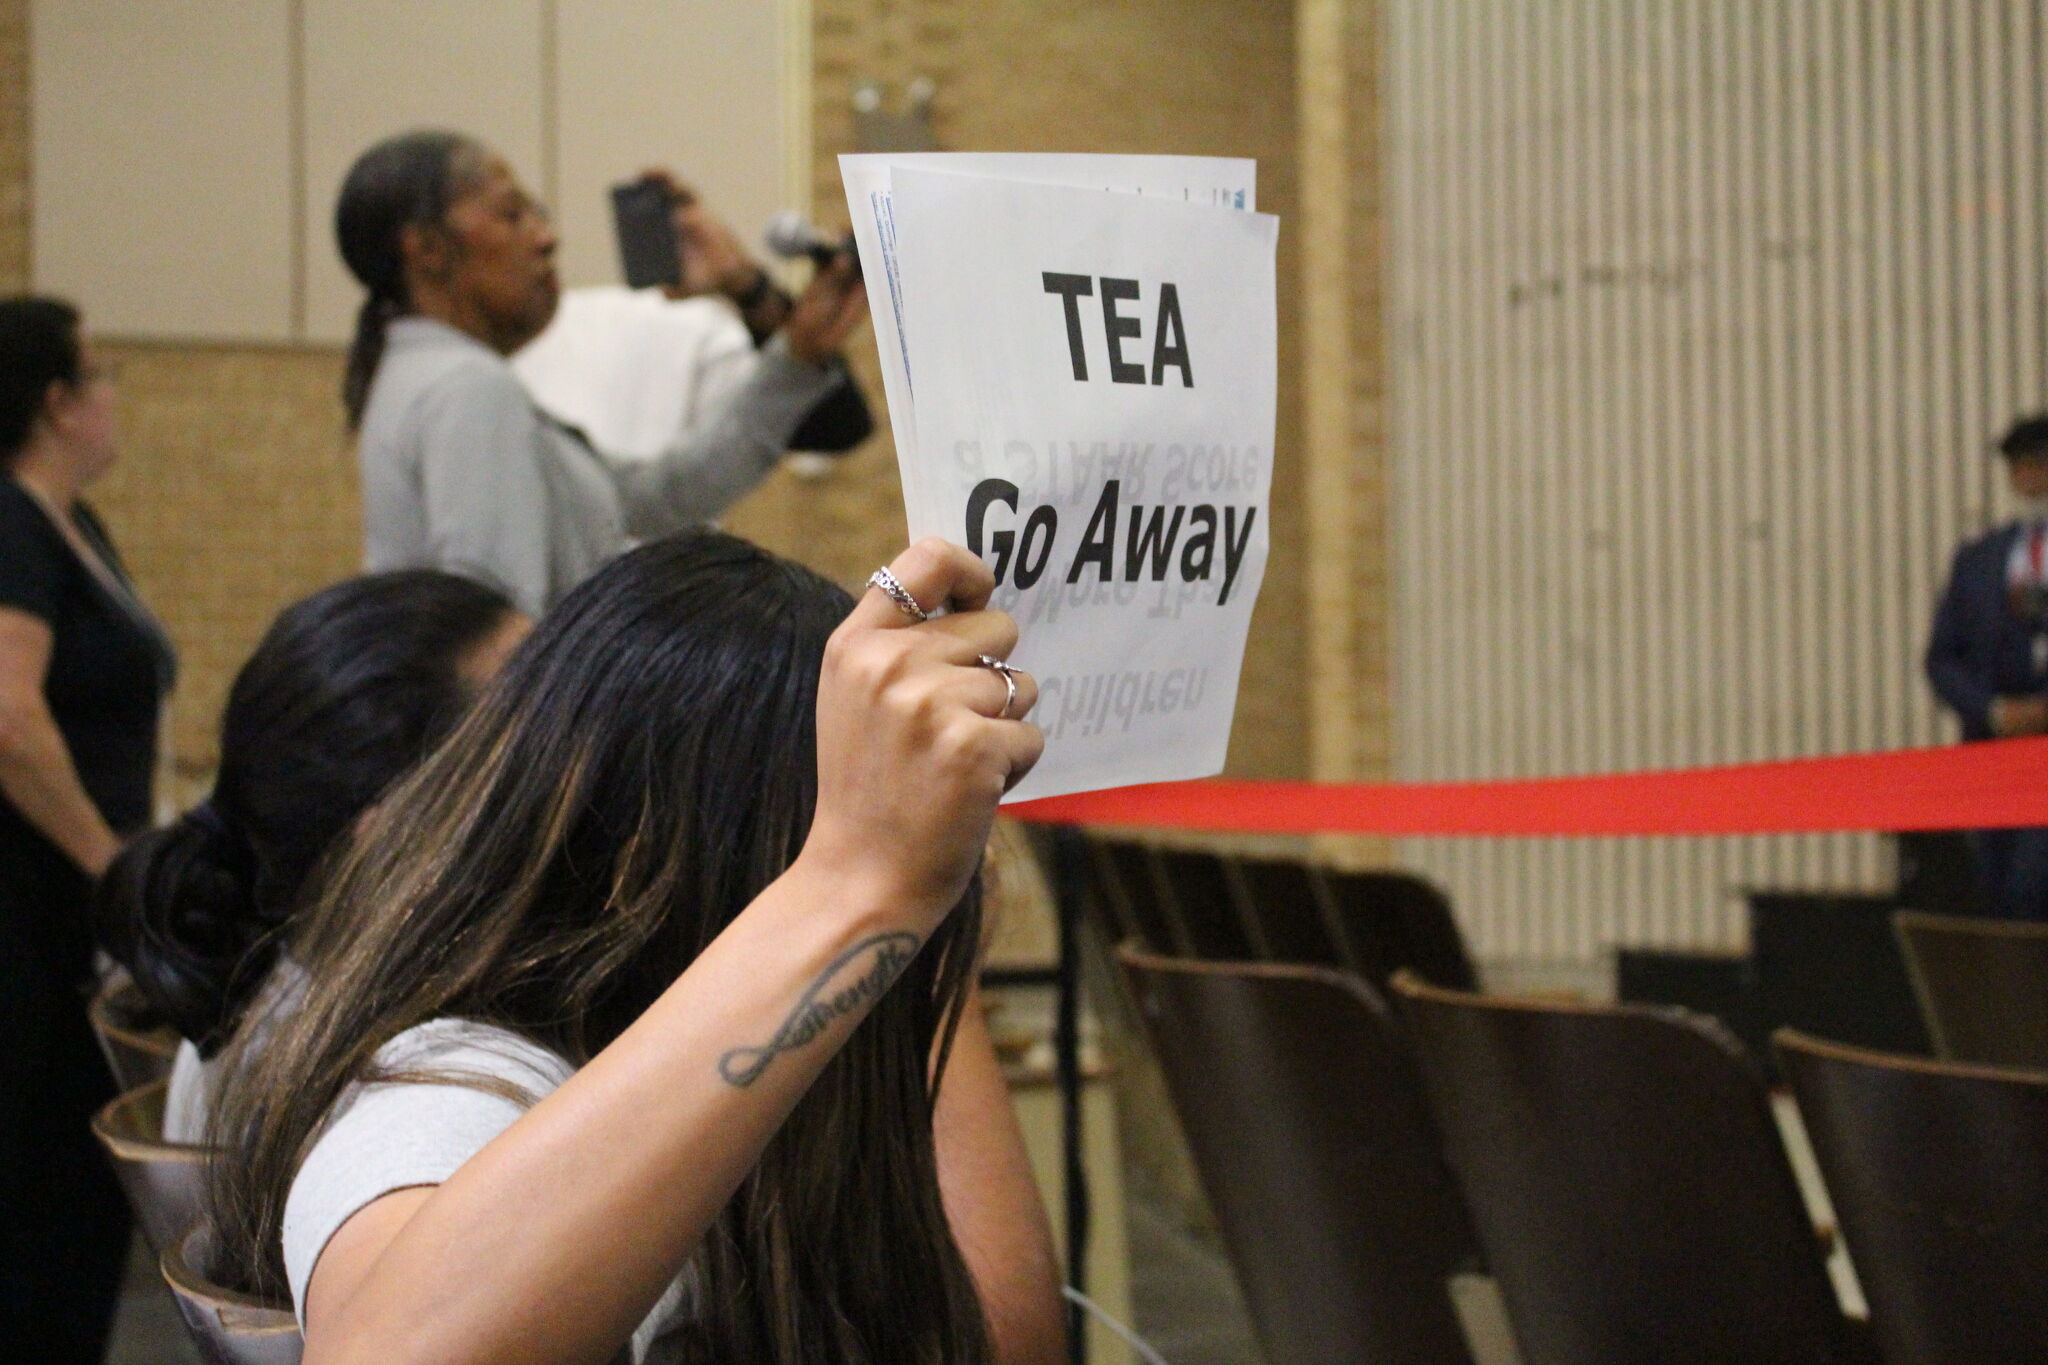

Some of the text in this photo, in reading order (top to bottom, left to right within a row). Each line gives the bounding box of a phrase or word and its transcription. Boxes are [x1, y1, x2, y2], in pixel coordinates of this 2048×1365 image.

[1042, 272, 1194, 388] TEA
[965, 478, 1257, 606] Go Away
